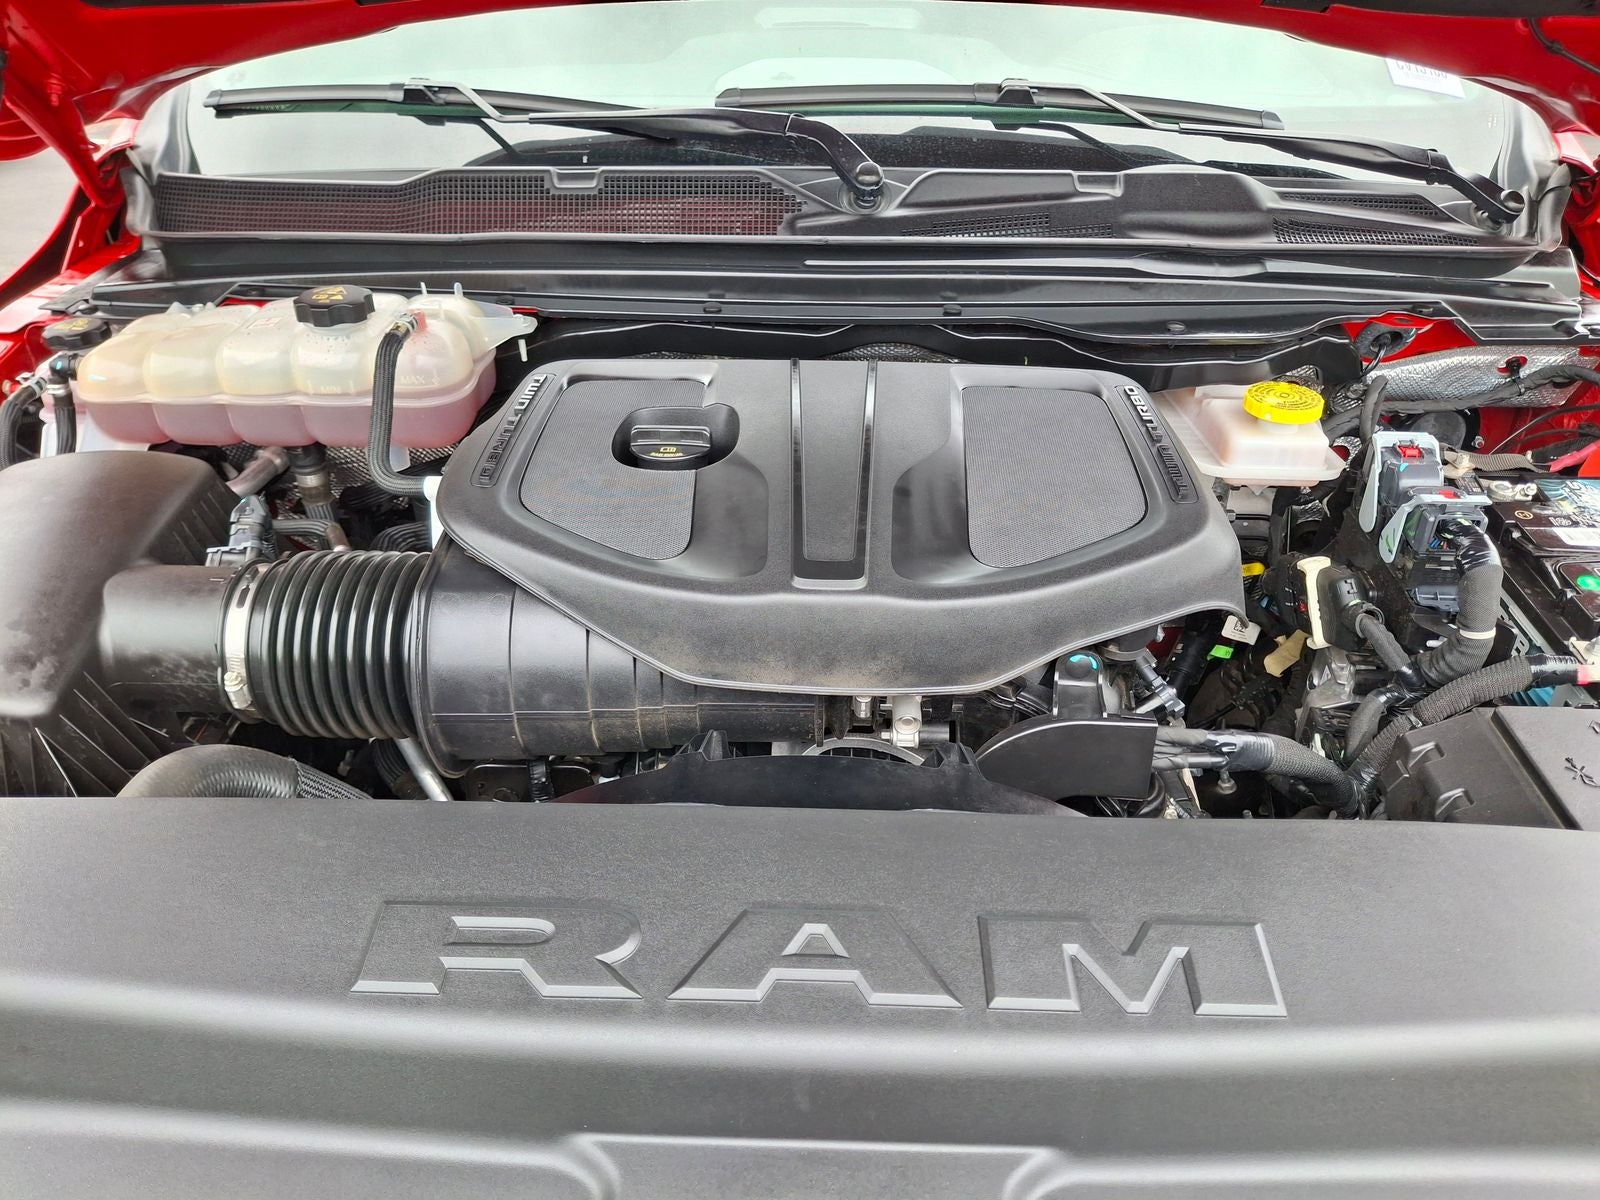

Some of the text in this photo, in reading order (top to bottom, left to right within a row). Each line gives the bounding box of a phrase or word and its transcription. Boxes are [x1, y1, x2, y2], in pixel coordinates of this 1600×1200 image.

[400, 376, 425, 385] MAX
[479, 373, 548, 482] TWIN TURBO
[1123, 385, 1189, 500] TWIN TURBO
[350, 897, 1289, 1017] RAM
